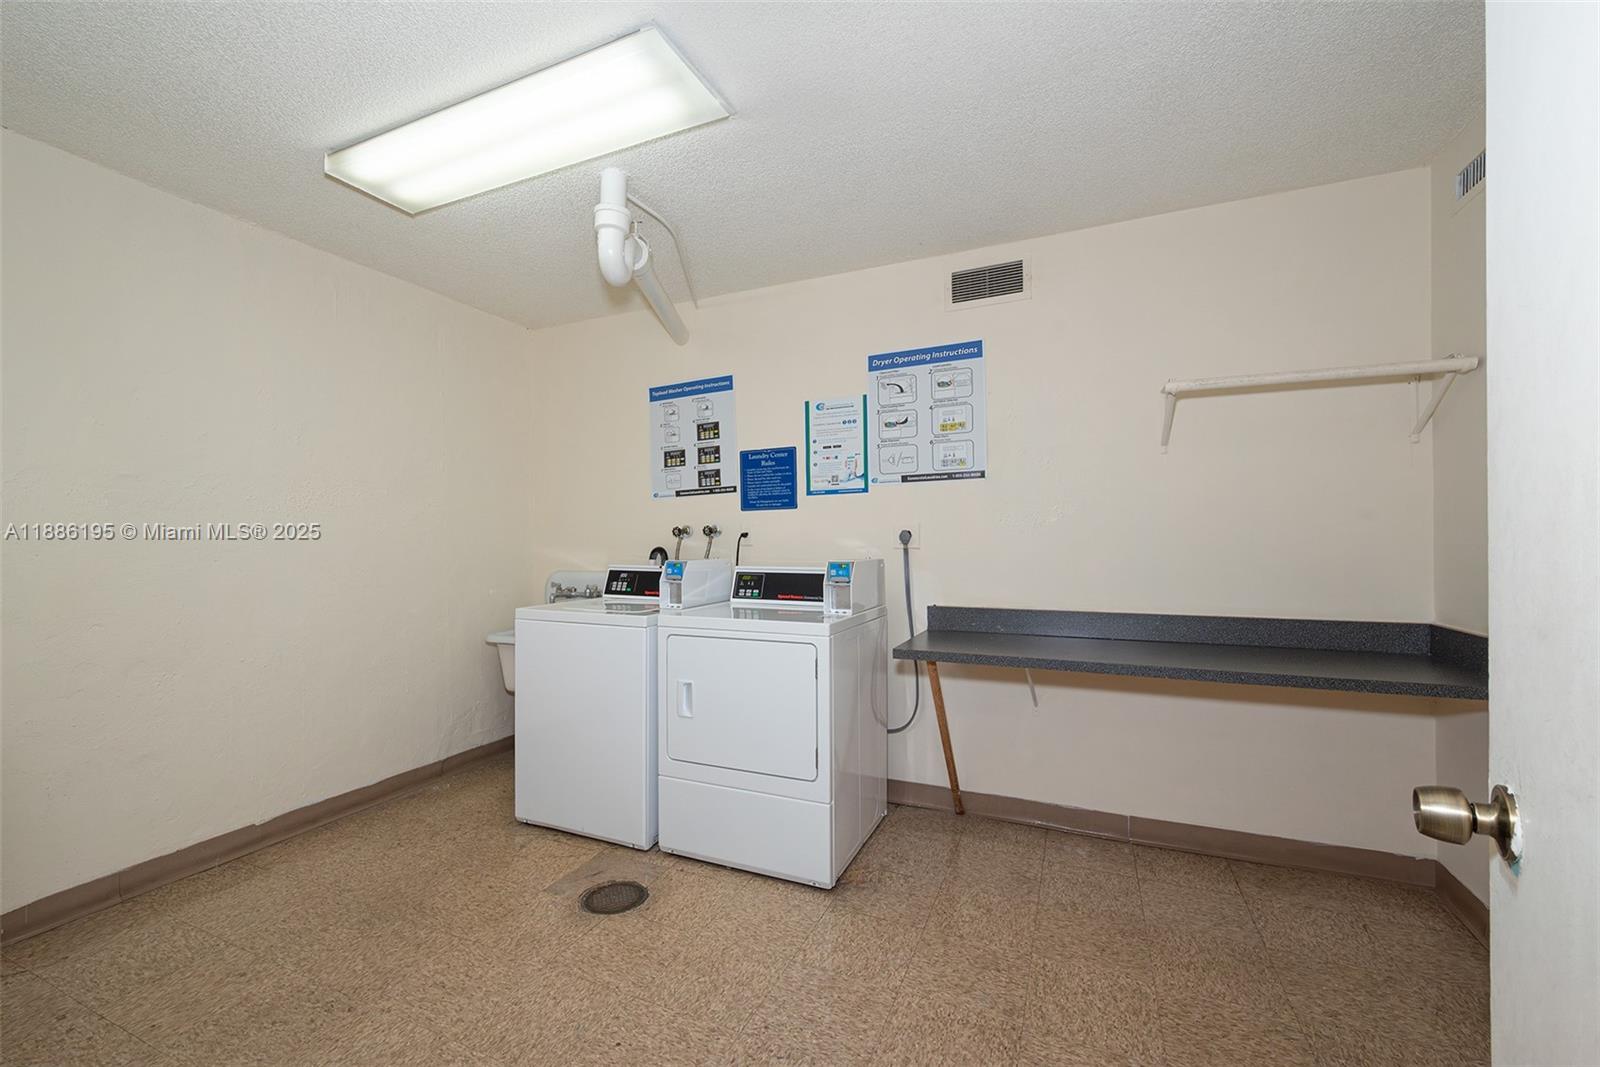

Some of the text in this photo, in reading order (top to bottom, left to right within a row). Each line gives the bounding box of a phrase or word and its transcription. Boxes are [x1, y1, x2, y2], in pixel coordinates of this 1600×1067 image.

[872, 346, 978, 367] Dryer Operating Instructions
